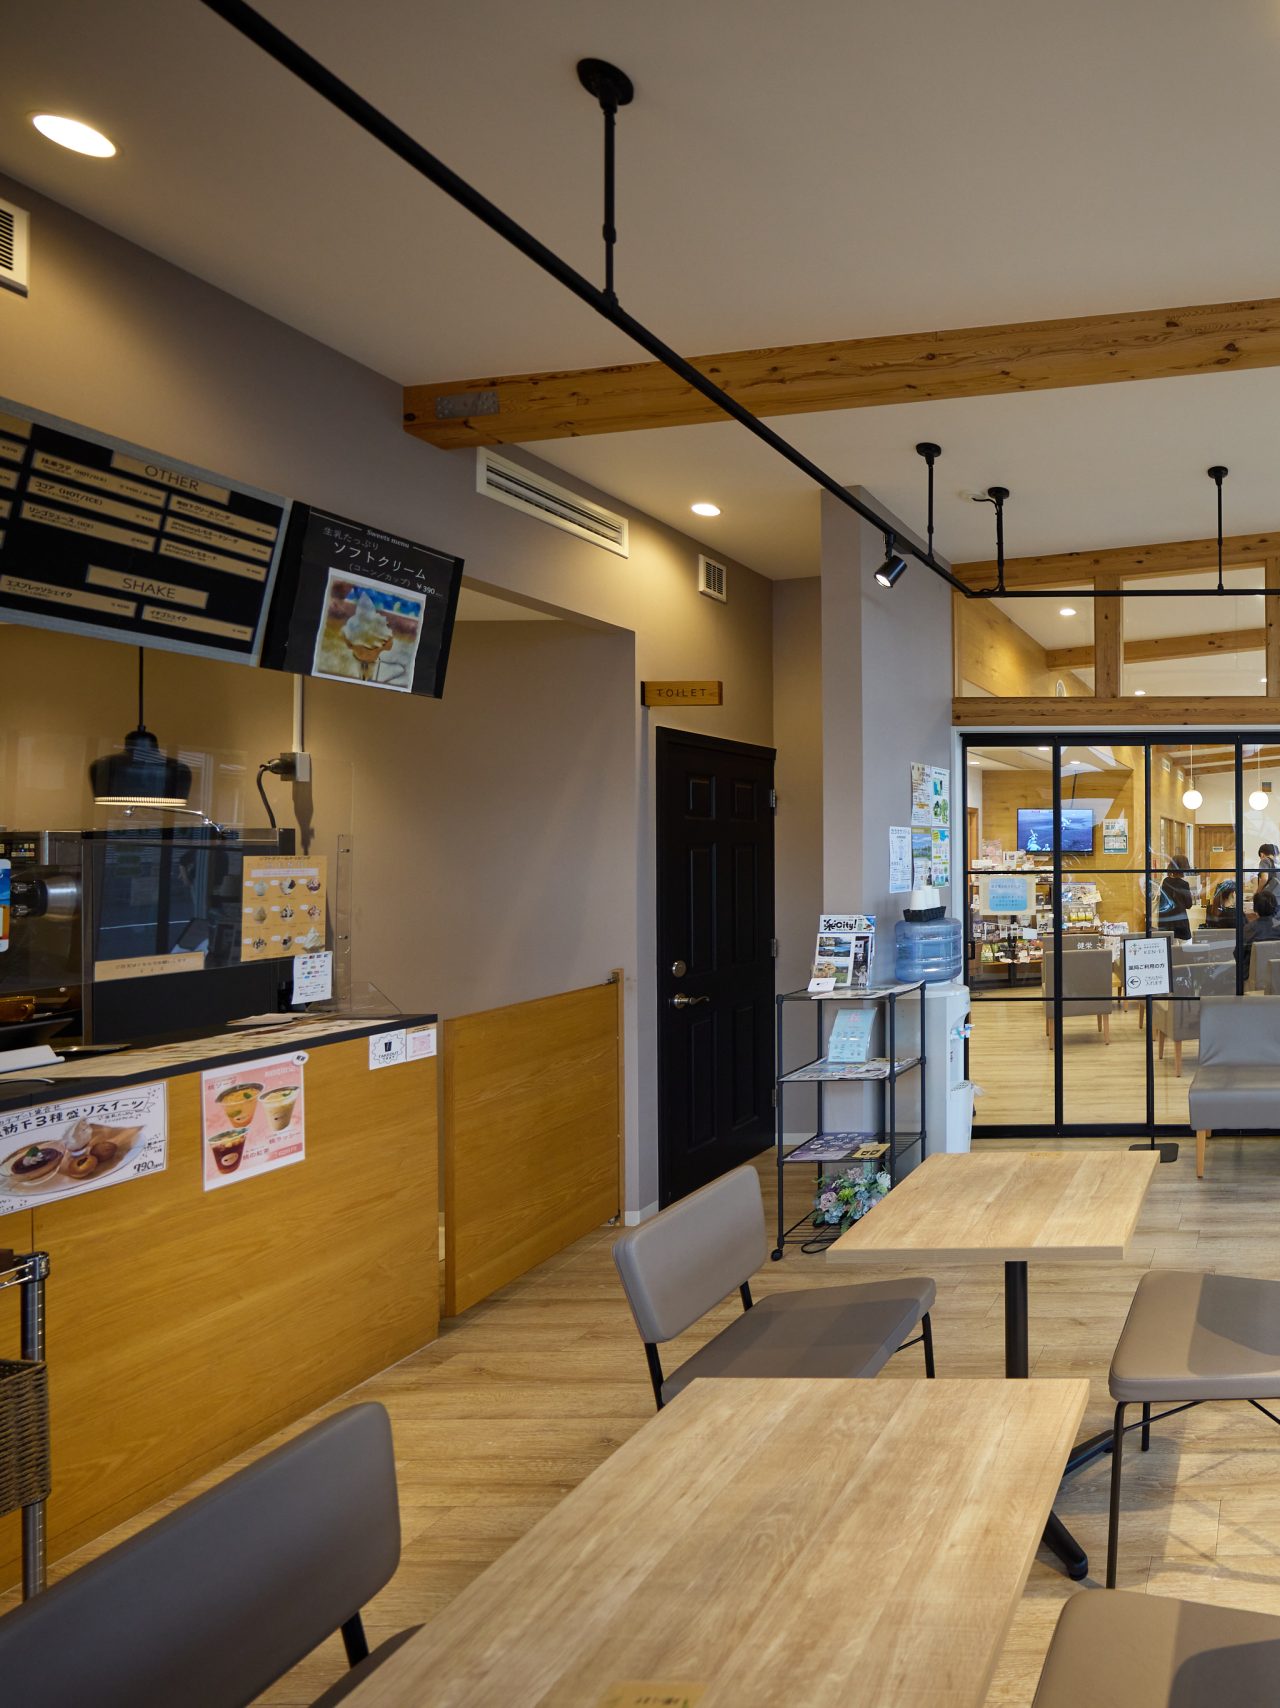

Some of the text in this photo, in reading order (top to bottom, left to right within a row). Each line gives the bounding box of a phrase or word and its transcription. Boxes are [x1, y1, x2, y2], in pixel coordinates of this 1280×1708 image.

[144, 464, 199, 492] OTHER
[334, 541, 426, 581] ソフトクリーム
[122, 577, 176, 600] SHAKE
[656, 688, 707, 698] TOILET
[0, 1100, 144, 1138] 訪下3種盛りスイーツ
